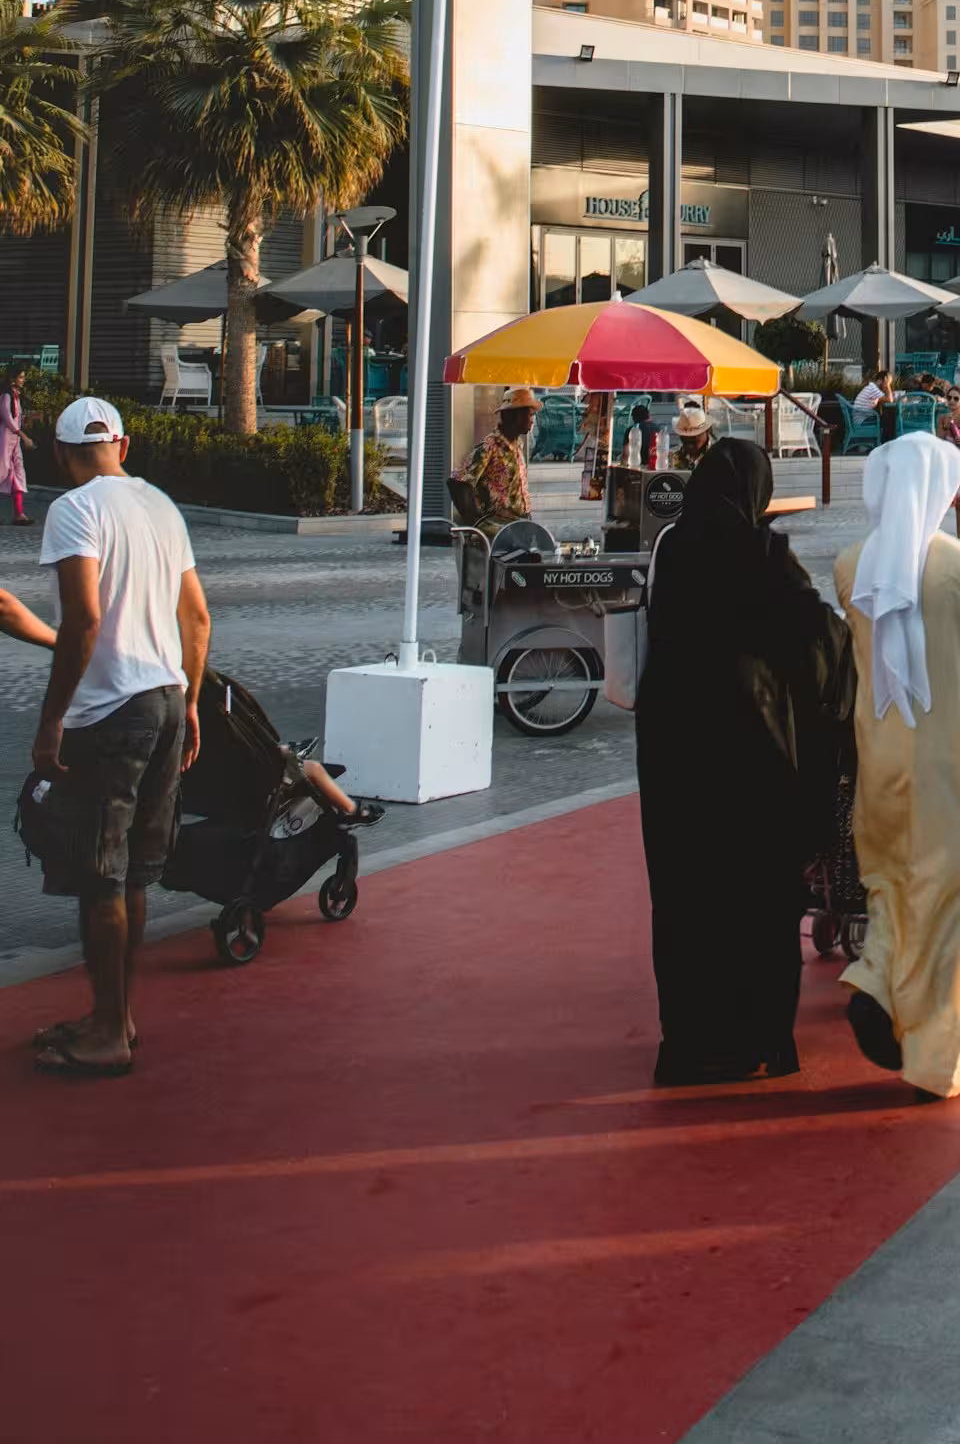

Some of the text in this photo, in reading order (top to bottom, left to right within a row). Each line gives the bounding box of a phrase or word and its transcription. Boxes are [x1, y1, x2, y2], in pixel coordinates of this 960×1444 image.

[585, 196, 640, 218] HOUSE
[680, 203, 712, 224] URRY
[543, 571, 614, 584] NY HOT DOGS
